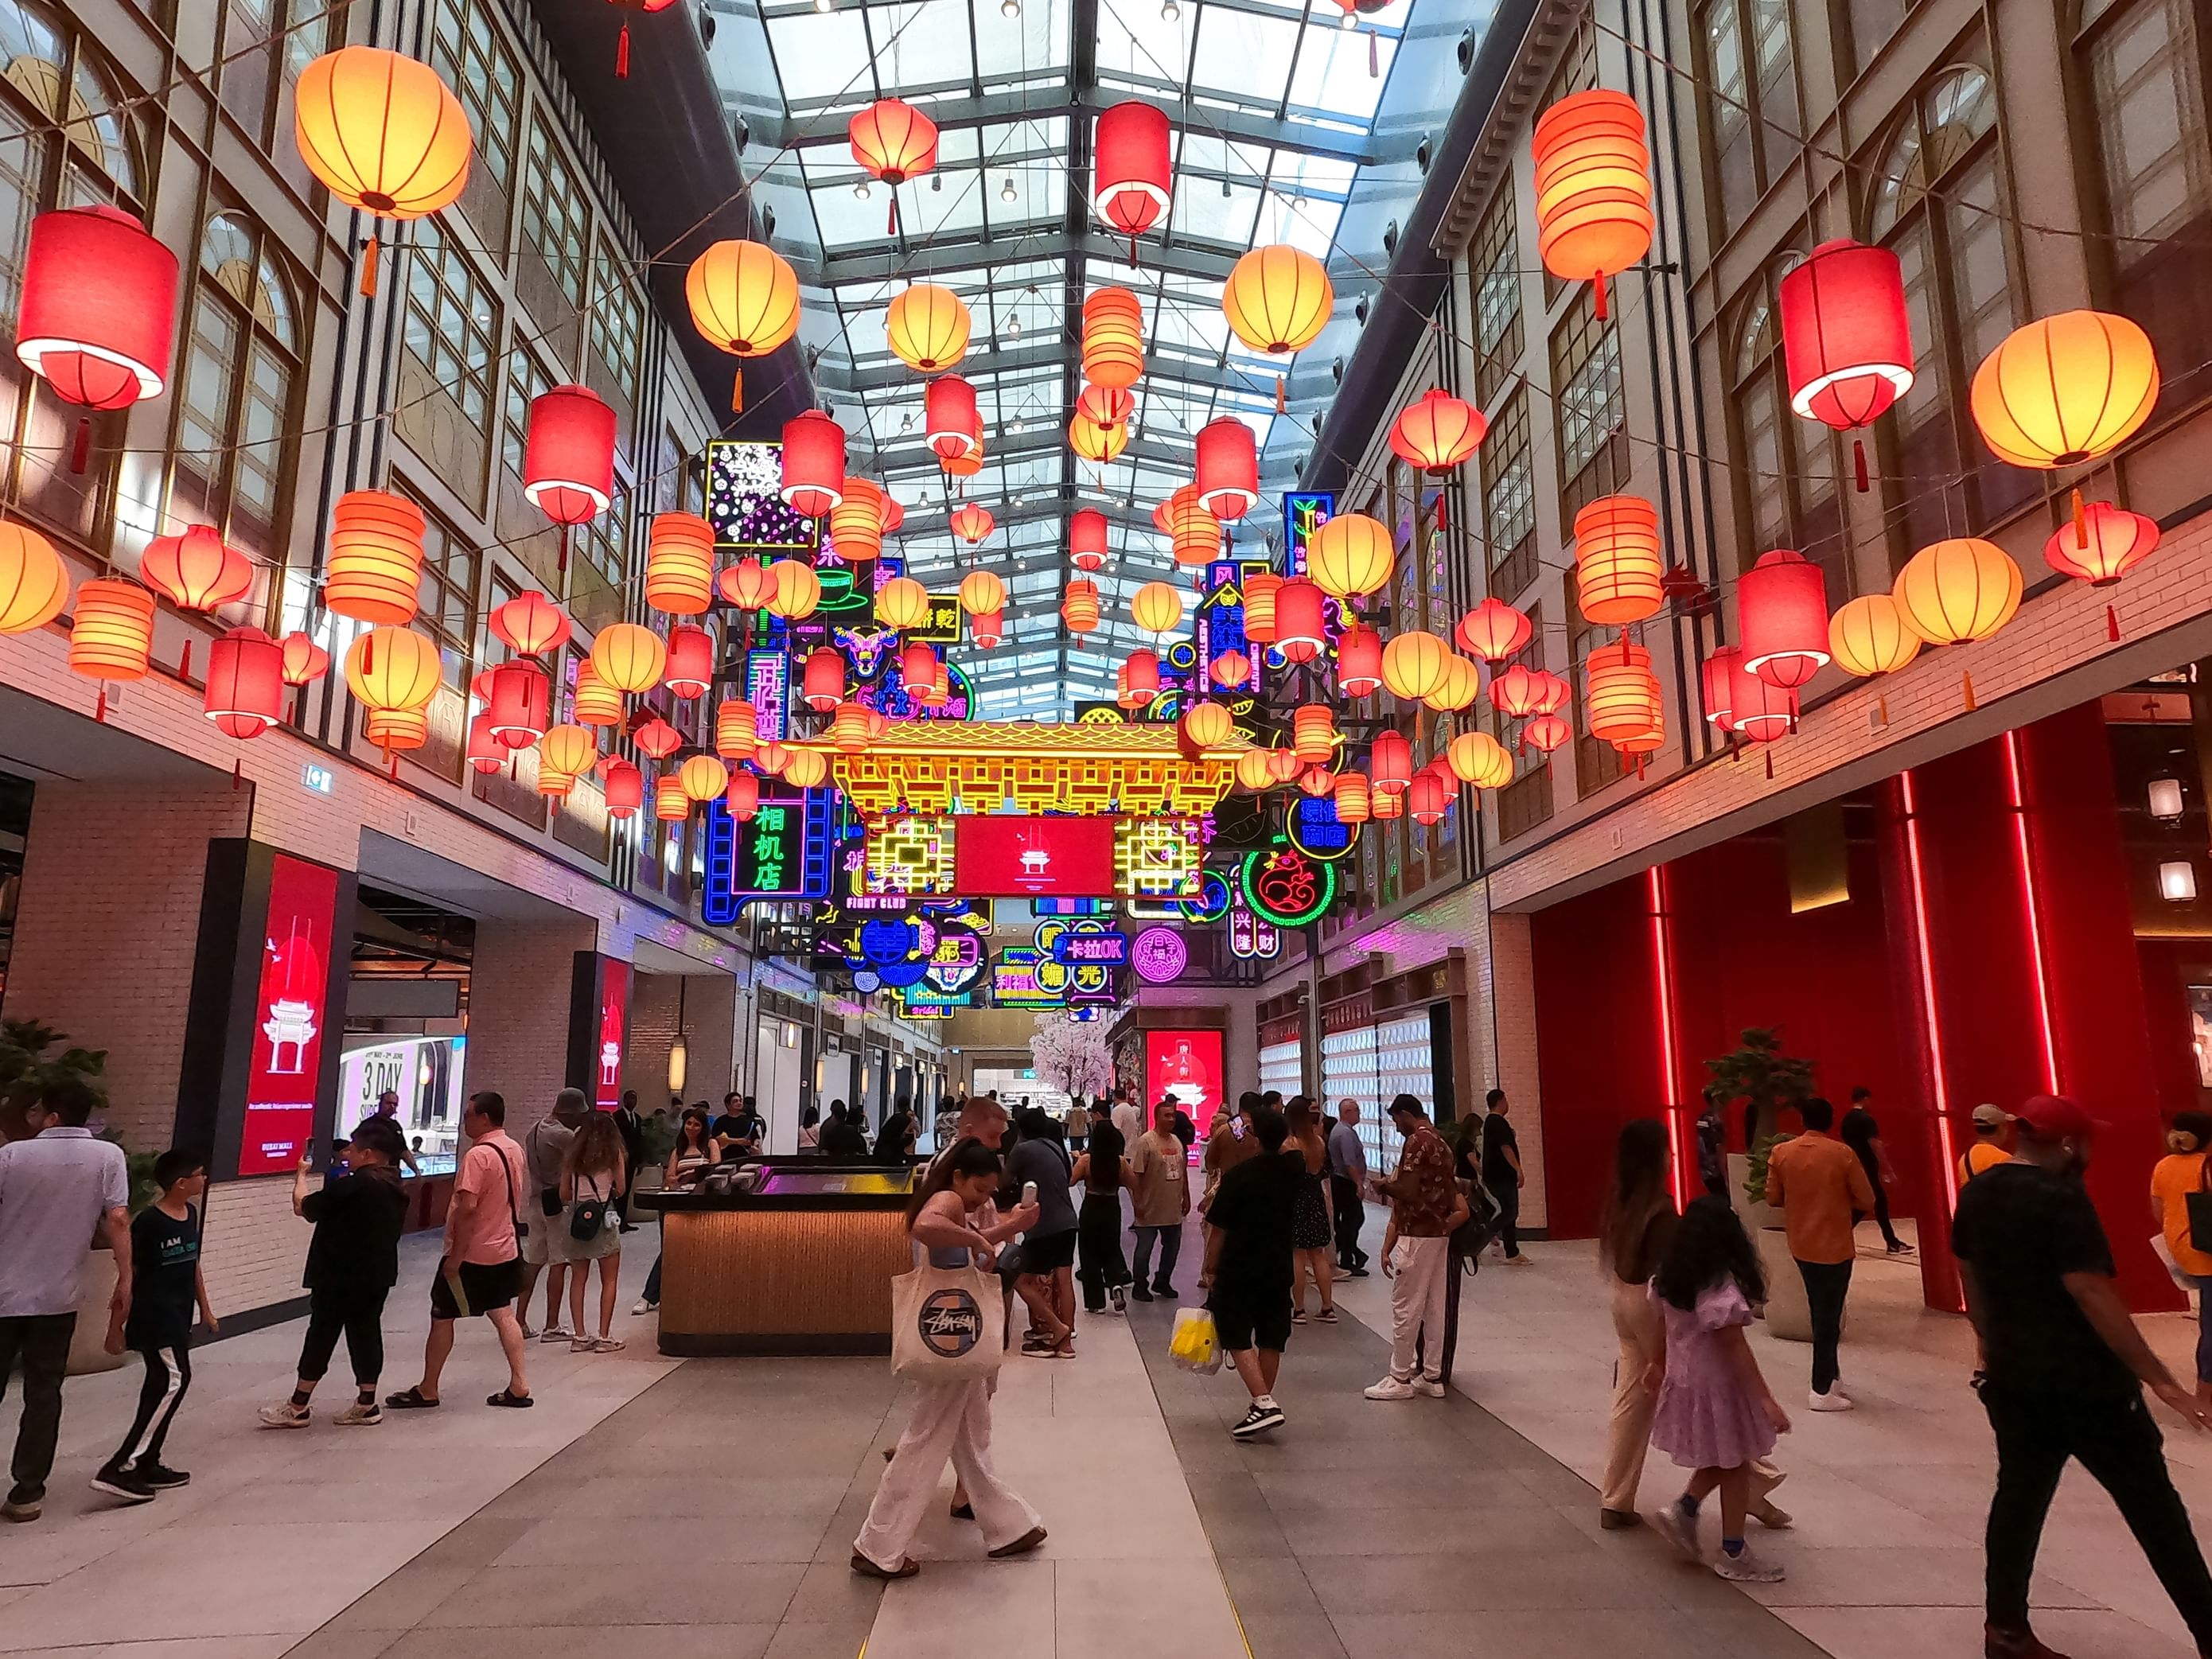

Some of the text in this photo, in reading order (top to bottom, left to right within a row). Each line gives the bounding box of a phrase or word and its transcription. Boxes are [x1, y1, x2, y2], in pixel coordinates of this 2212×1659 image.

[1198, 618, 1210, 693] AESTHETICS
[1302, 824, 1346, 847] 商店
[754, 806, 785, 891] 相机店
[847, 898, 906, 909] FIGHT CLUB
[1067, 939, 1123, 959] 卡拉OK
[363, 1061, 403, 1101] 3 DAY
[166, 1236, 181, 1248] AM
